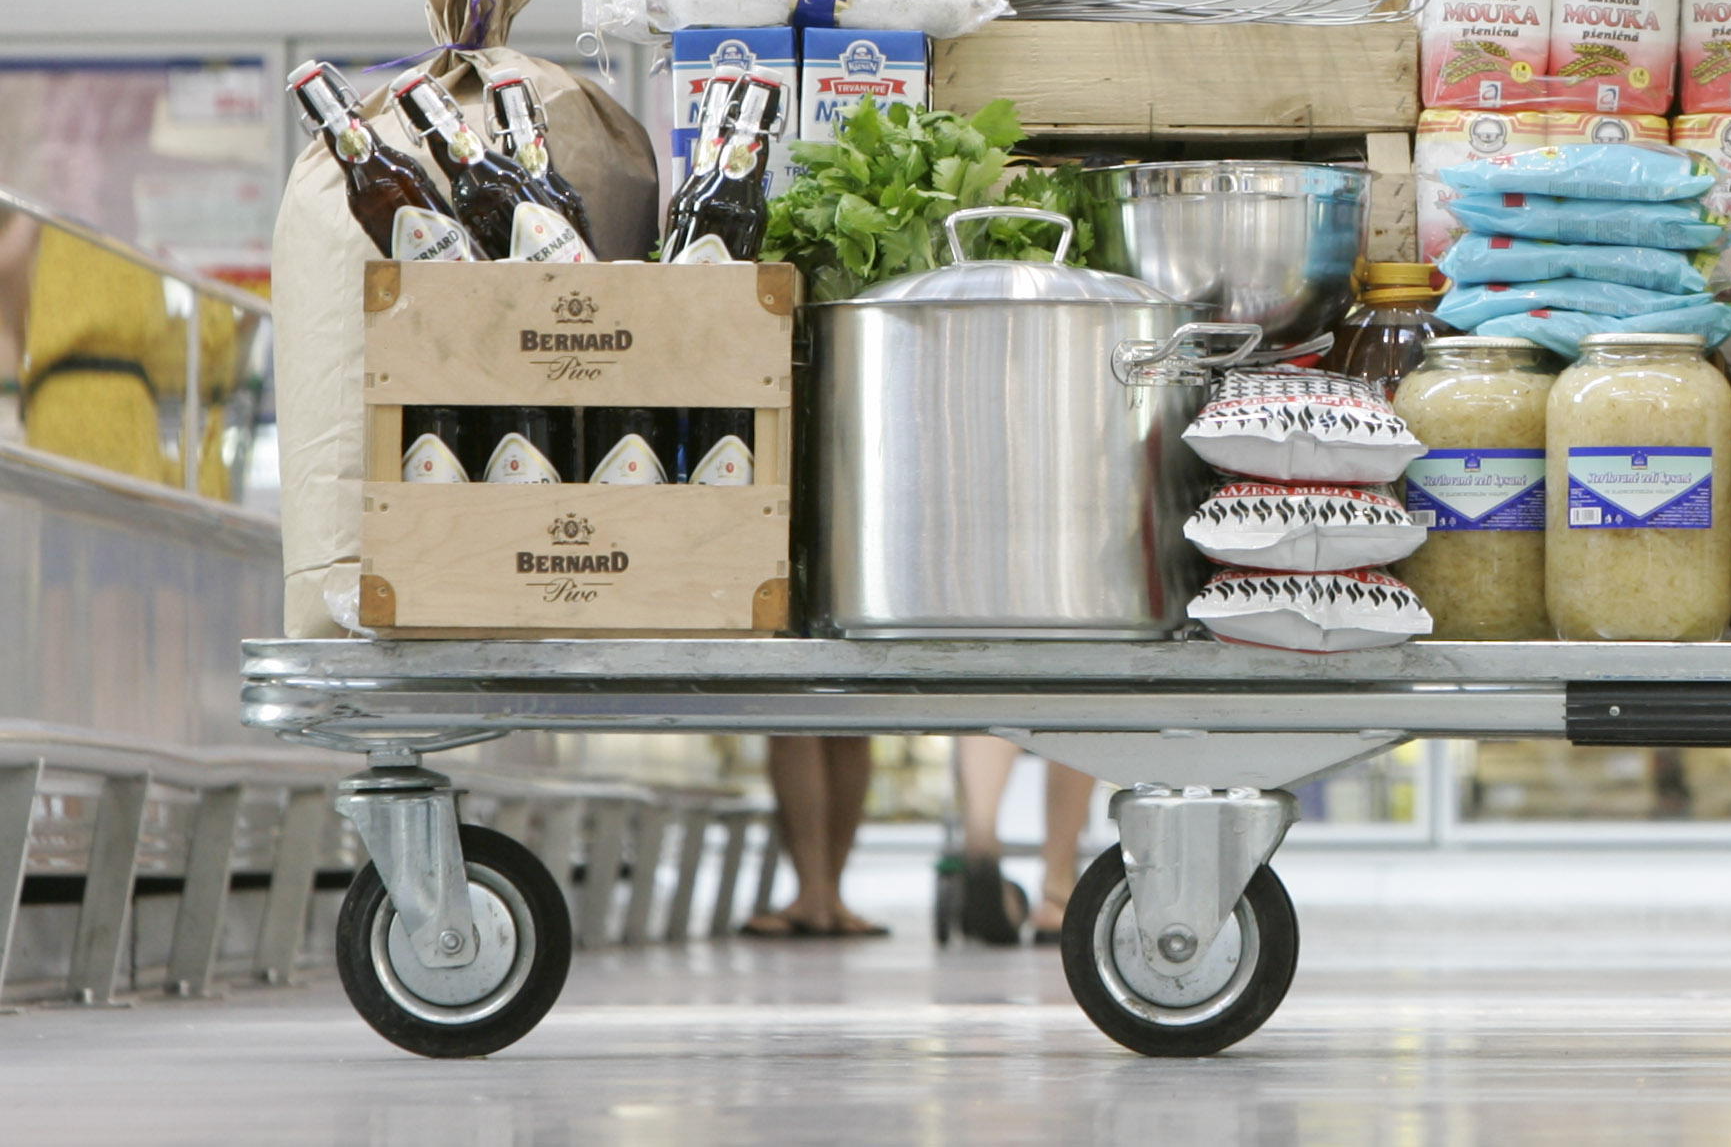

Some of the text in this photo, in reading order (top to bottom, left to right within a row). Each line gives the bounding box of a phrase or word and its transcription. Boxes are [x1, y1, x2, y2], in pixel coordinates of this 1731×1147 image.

[1442, 2, 1540, 25] MOUKA
[1563, 4, 1660, 31] MOUKA
[412, 229, 459, 261] RNARD
[520, 329, 633, 353] BERNARD
[546, 355, 602, 381] Pivo
[516, 551, 629, 574] BERNARD
[543, 577, 599, 603] Pivo
